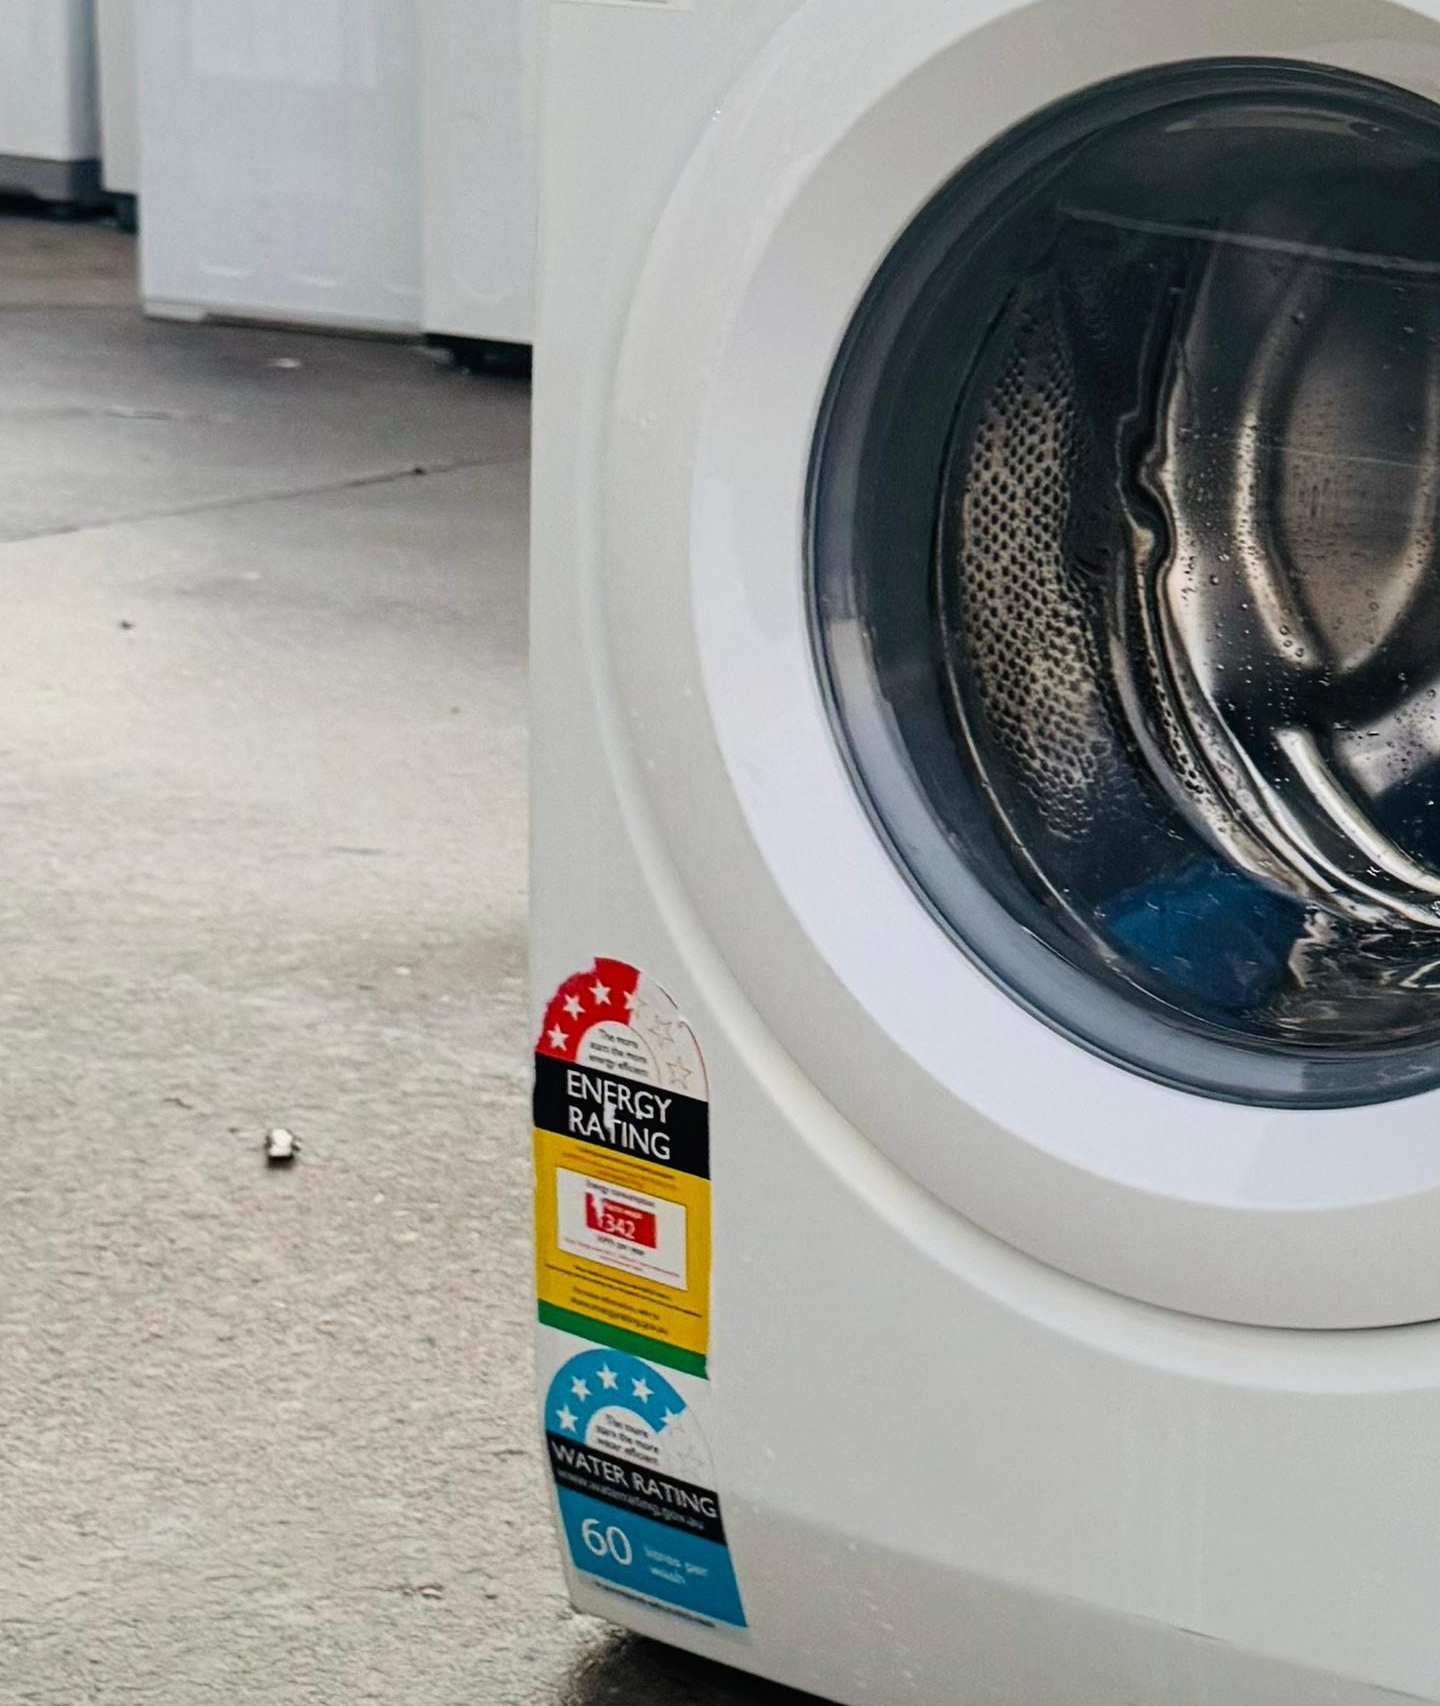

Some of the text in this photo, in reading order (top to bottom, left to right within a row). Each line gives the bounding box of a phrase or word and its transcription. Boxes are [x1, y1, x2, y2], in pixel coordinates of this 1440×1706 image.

[567, 1069, 672, 1124] ENERGY
[569, 1105, 671, 1161] RATING
[551, 1441, 718, 1518] WATER RATING
[581, 1518, 633, 1565] 60
